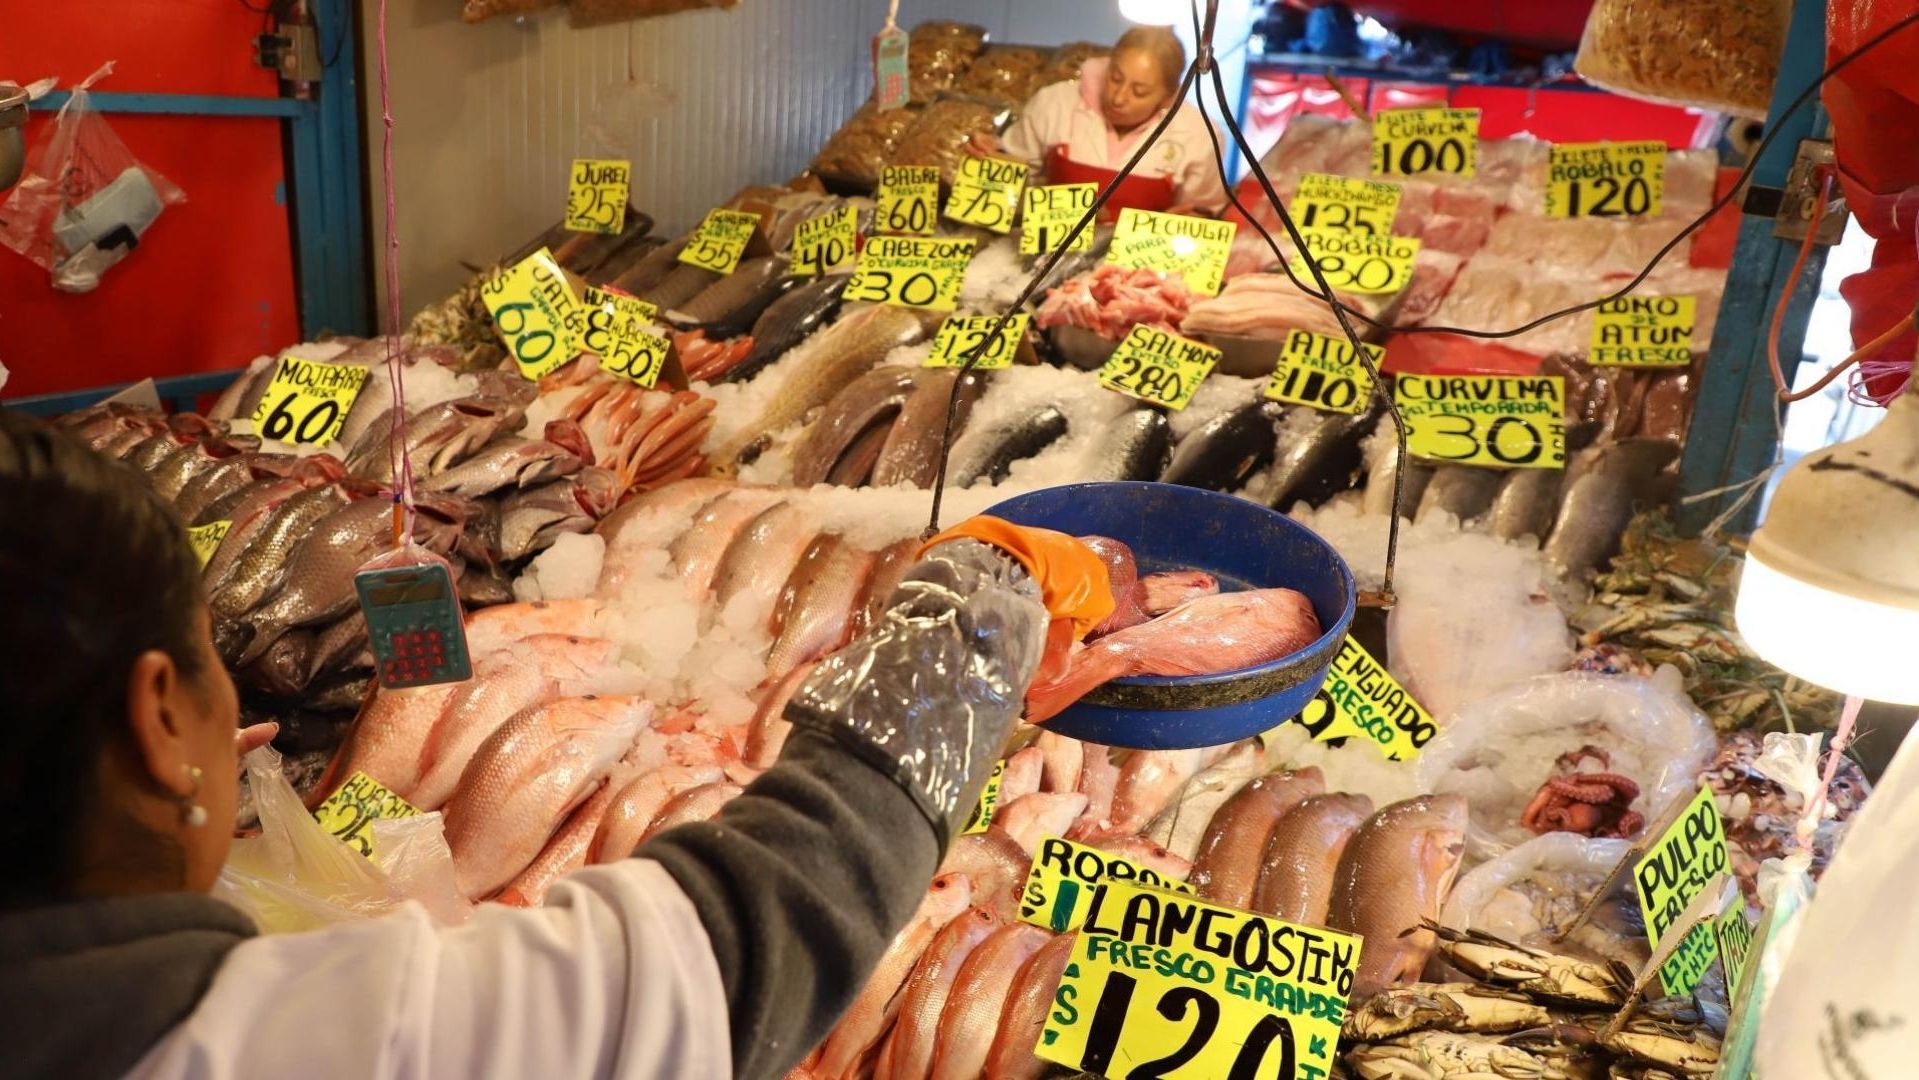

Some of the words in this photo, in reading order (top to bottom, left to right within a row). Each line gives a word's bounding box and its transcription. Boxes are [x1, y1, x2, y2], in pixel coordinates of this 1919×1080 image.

[576, 163, 628, 185] JUREL
[1551, 159, 1645, 181] ROBALO
[1029, 186, 1096, 213] PETO
[1132, 212, 1230, 243] PECHUGA
[1304, 233, 1412, 259] ROBALO
[1600, 297, 1678, 316] LOMO
[945, 317, 1017, 330] MERO
[1601, 324, 1693, 345] ATUN
[1290, 331, 1382, 367] ATUN
[1593, 347, 1691, 361] FRESCO
[1398, 376, 1559, 401] CURVINA
[1421, 400, 1551, 415] TEMPORADA
[1332, 640, 1436, 749] ENGUADO
[1639, 800, 1717, 911] PULPO
[1082, 884, 1354, 997] LANGOSTINO
[1086, 936, 1215, 983] FRESCO
[1224, 967, 1348, 1026] GRANDE
